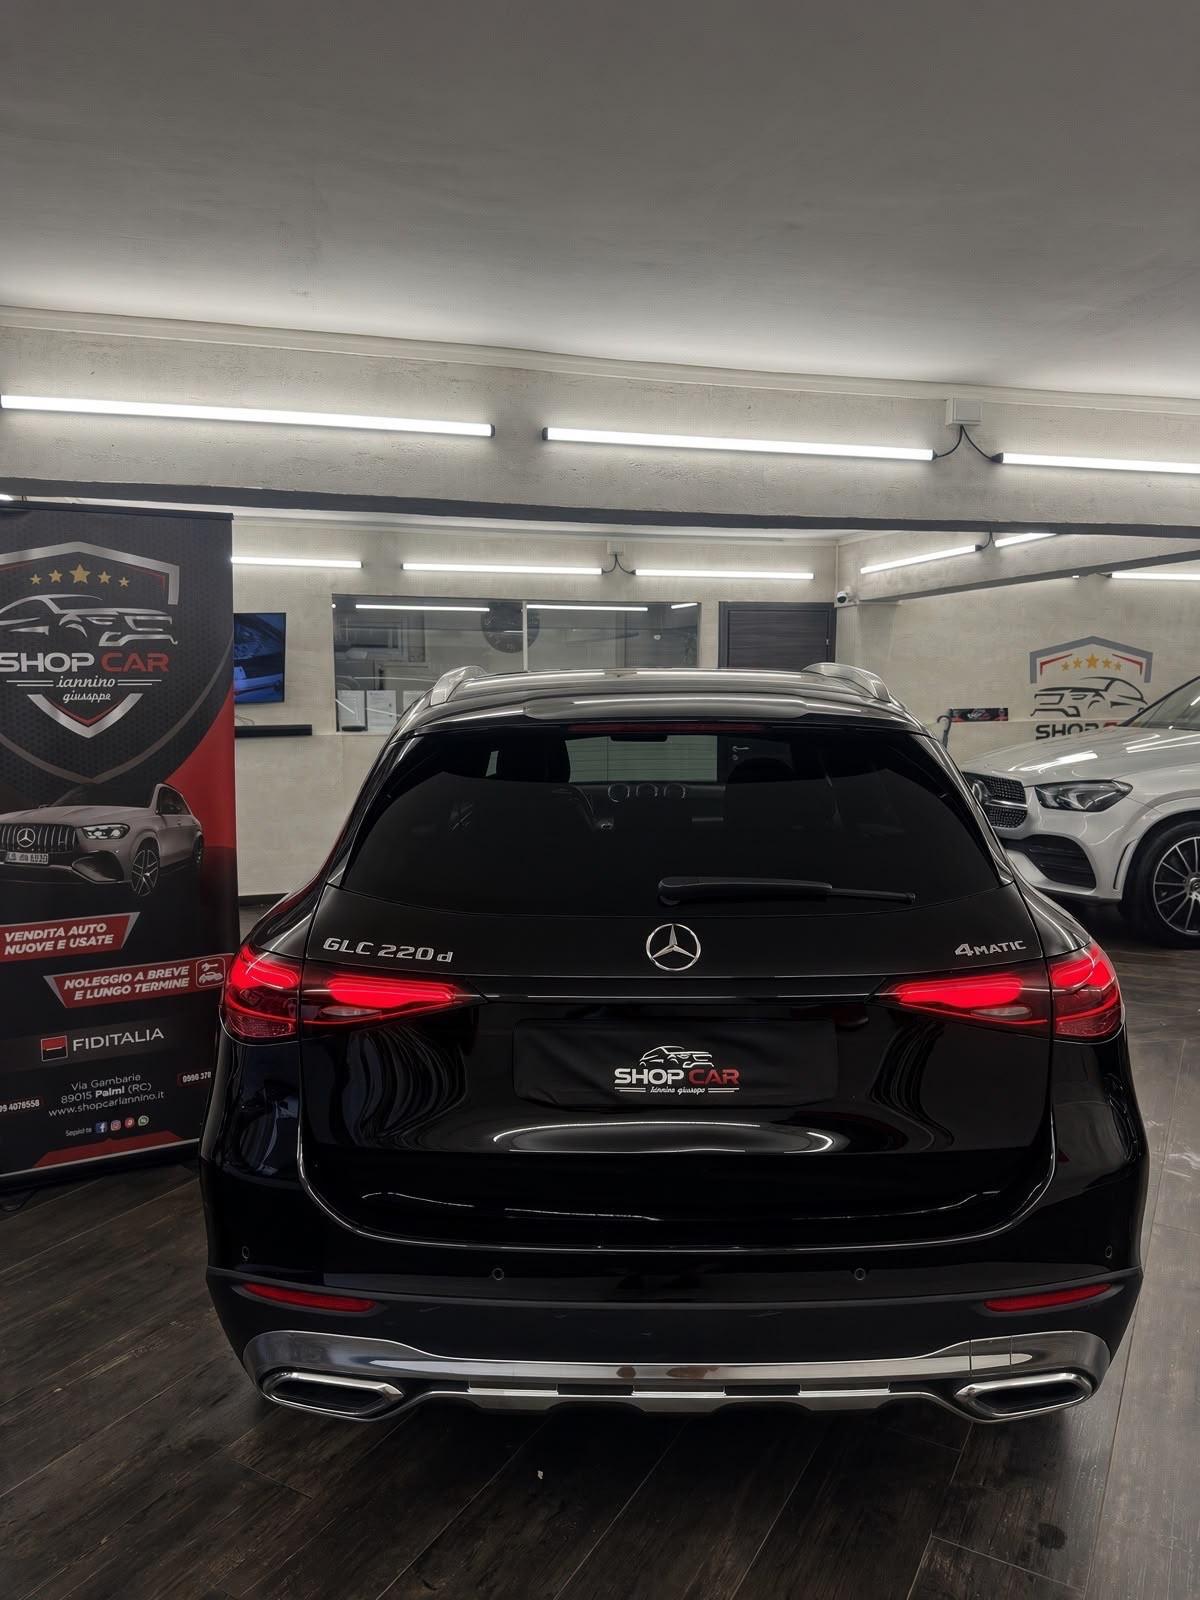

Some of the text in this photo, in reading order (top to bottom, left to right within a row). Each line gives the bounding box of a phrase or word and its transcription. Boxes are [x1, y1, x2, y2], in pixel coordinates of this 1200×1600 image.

[0, 652, 169, 673] SHOP CAR
[56, 675, 116, 688] iannino
[4, 923, 107, 943] VENDITA AUTO
[4, 934, 114, 955] NUOVE E USATE
[323, 937, 374, 955] GLC
[954, 940, 1027, 956] 4MATIC
[64, 966, 190, 990] NOLEGGIO A BREVE
[74, 977, 190, 1001] E LUNGO TERMINE
[72, 1028, 165, 1052] FIDITALIA
[71, 1081, 88, 1091] Via
[614, 1068, 740, 1085] SHOP CAR
[61, 1082, 152, 1104] 89015 Palmi (RC)
